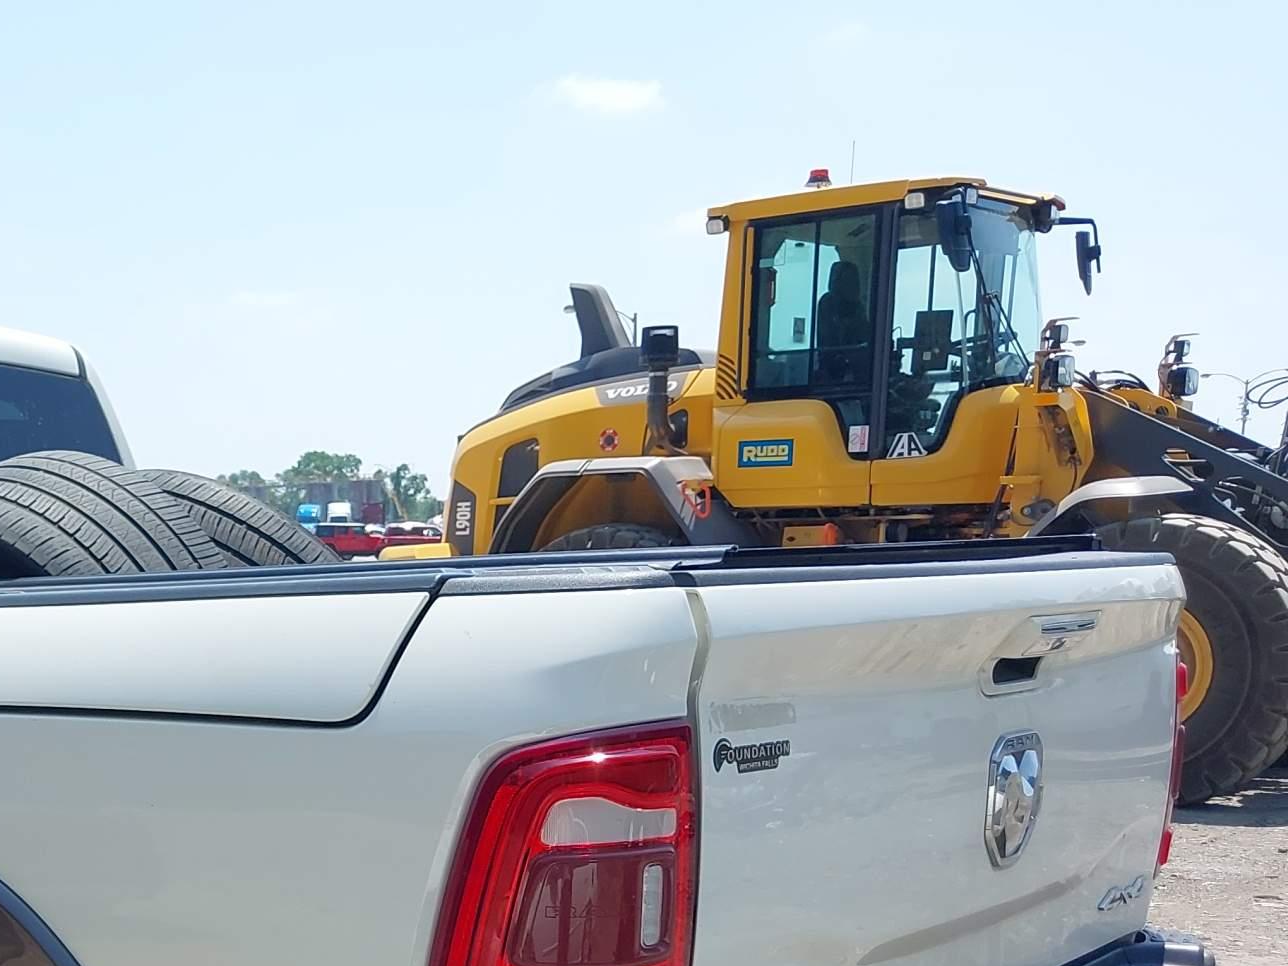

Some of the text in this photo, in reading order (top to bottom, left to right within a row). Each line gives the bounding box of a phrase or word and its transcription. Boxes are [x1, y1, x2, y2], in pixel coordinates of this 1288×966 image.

[605, 381, 678, 399] VOLO
[743, 445, 789, 462] RUDD
[455, 502, 472, 536] L90H
[714, 739, 791, 769] FOUNDATION
